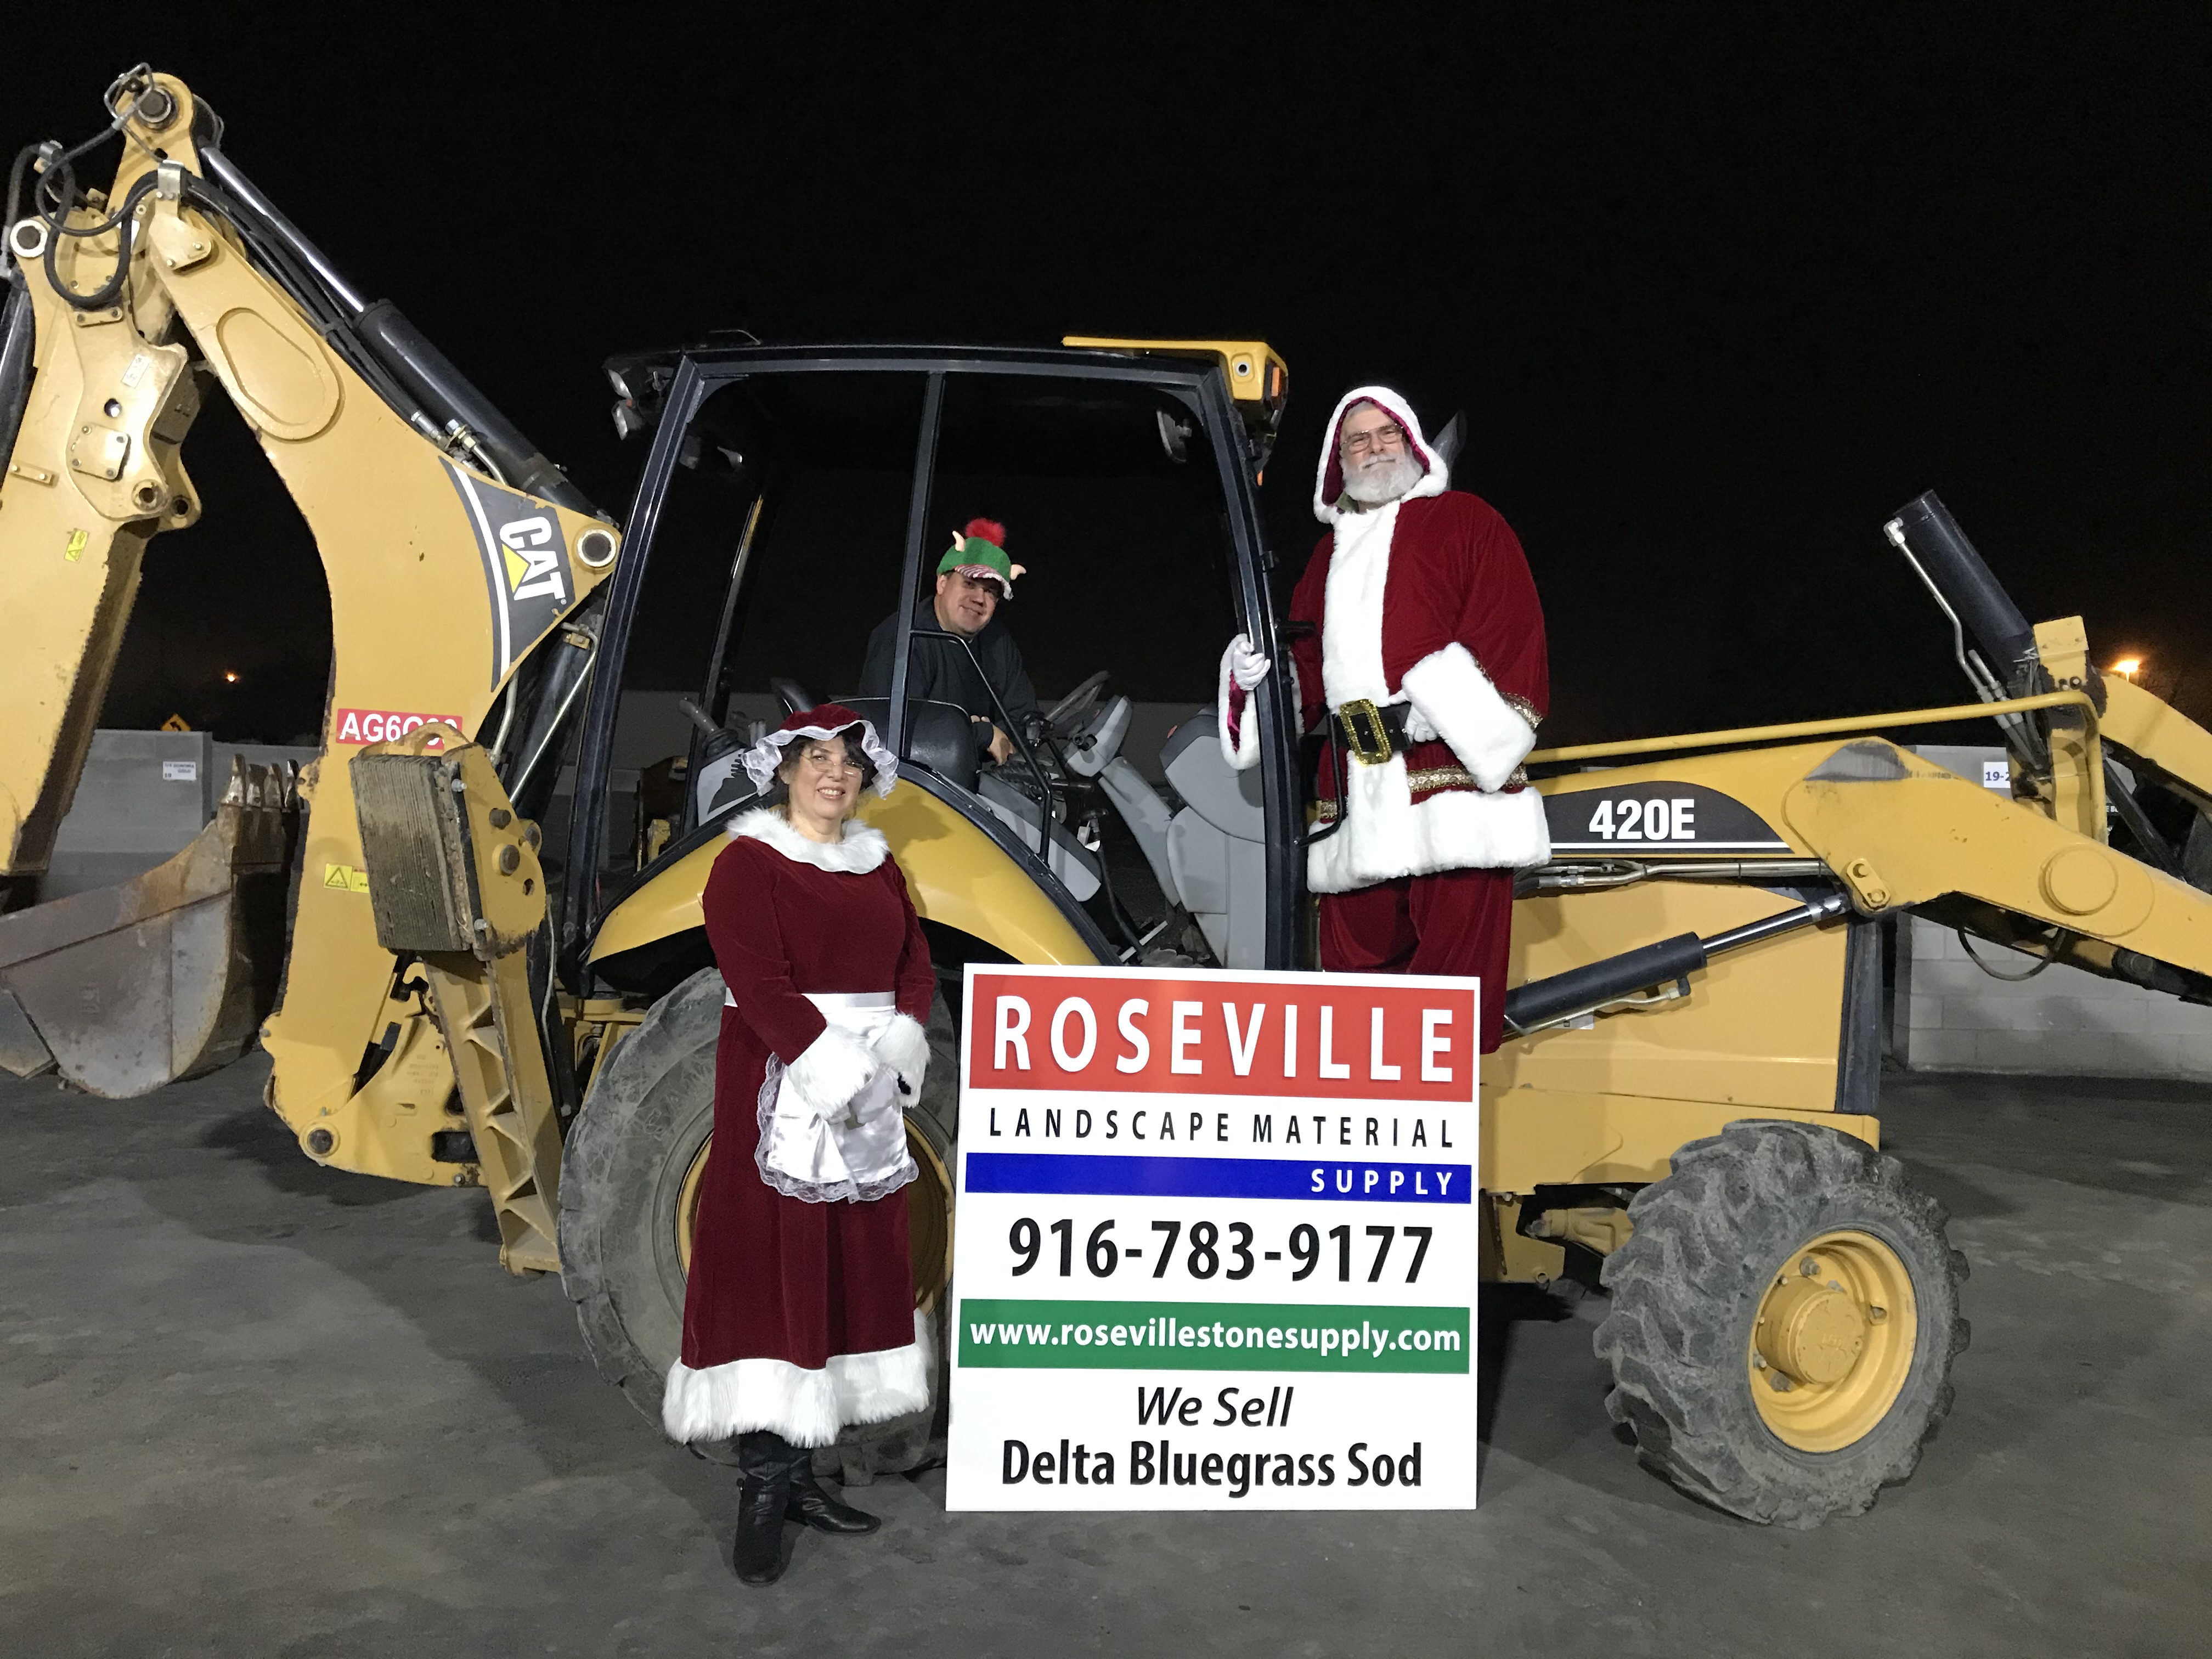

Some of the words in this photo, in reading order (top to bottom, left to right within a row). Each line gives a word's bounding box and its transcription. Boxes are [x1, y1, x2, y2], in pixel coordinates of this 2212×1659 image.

[500, 517, 566, 601] CAT
[339, 712, 458, 746] AG6
[1589, 799, 1695, 840] 420E
[994, 996, 1453, 1082] ROSEVILLE
[990, 1108, 1228, 1142] LANDSCAPE
[1252, 1114, 1453, 1148] MATERIAL
[1311, 1169, 1452, 1195] SUPPLY
[1009, 1218, 1432, 1283] 916-783-9177
[970, 1318, 1460, 1358] www.rosevillestonesupply.com
[1138, 1387, 1202, 1426] We
[1213, 1387, 1294, 1427] Sell
[1003, 1440, 1114, 1485] Delta
[1130, 1440, 1335, 1498] Bluegrass
[1348, 1442, 1421, 1487] Sod
